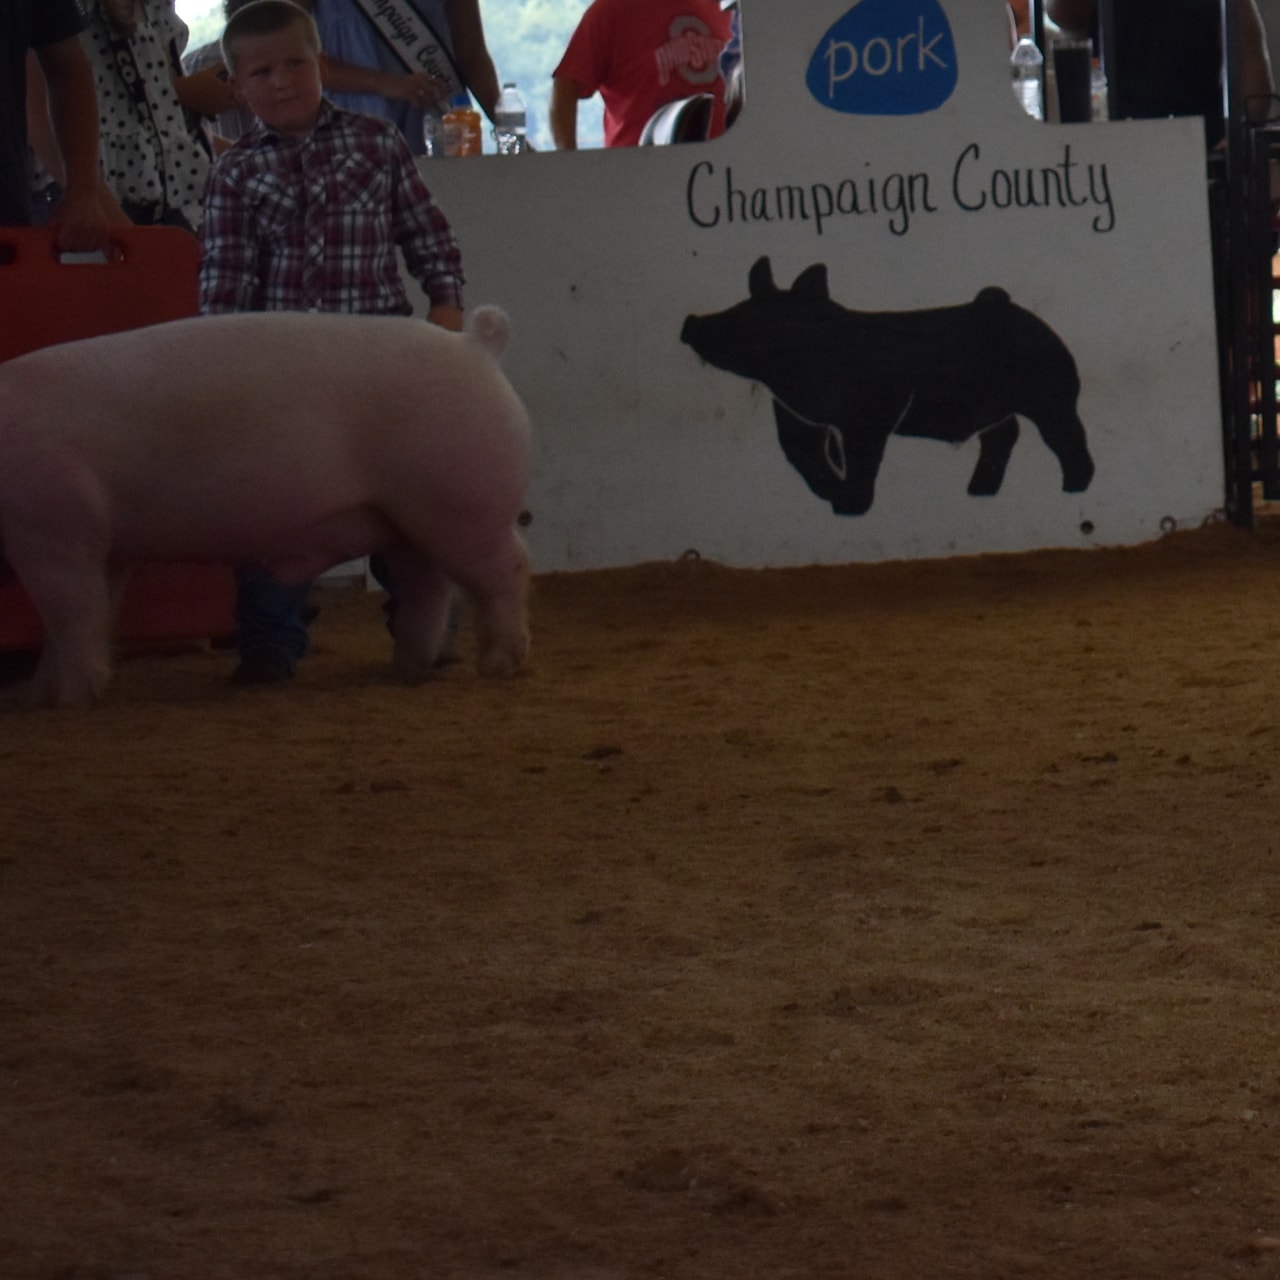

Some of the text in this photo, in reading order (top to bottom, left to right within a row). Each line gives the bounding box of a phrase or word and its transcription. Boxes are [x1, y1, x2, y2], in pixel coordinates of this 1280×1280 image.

[823, 16, 949, 97] pork
[686, 142, 1116, 236] Champaign County
